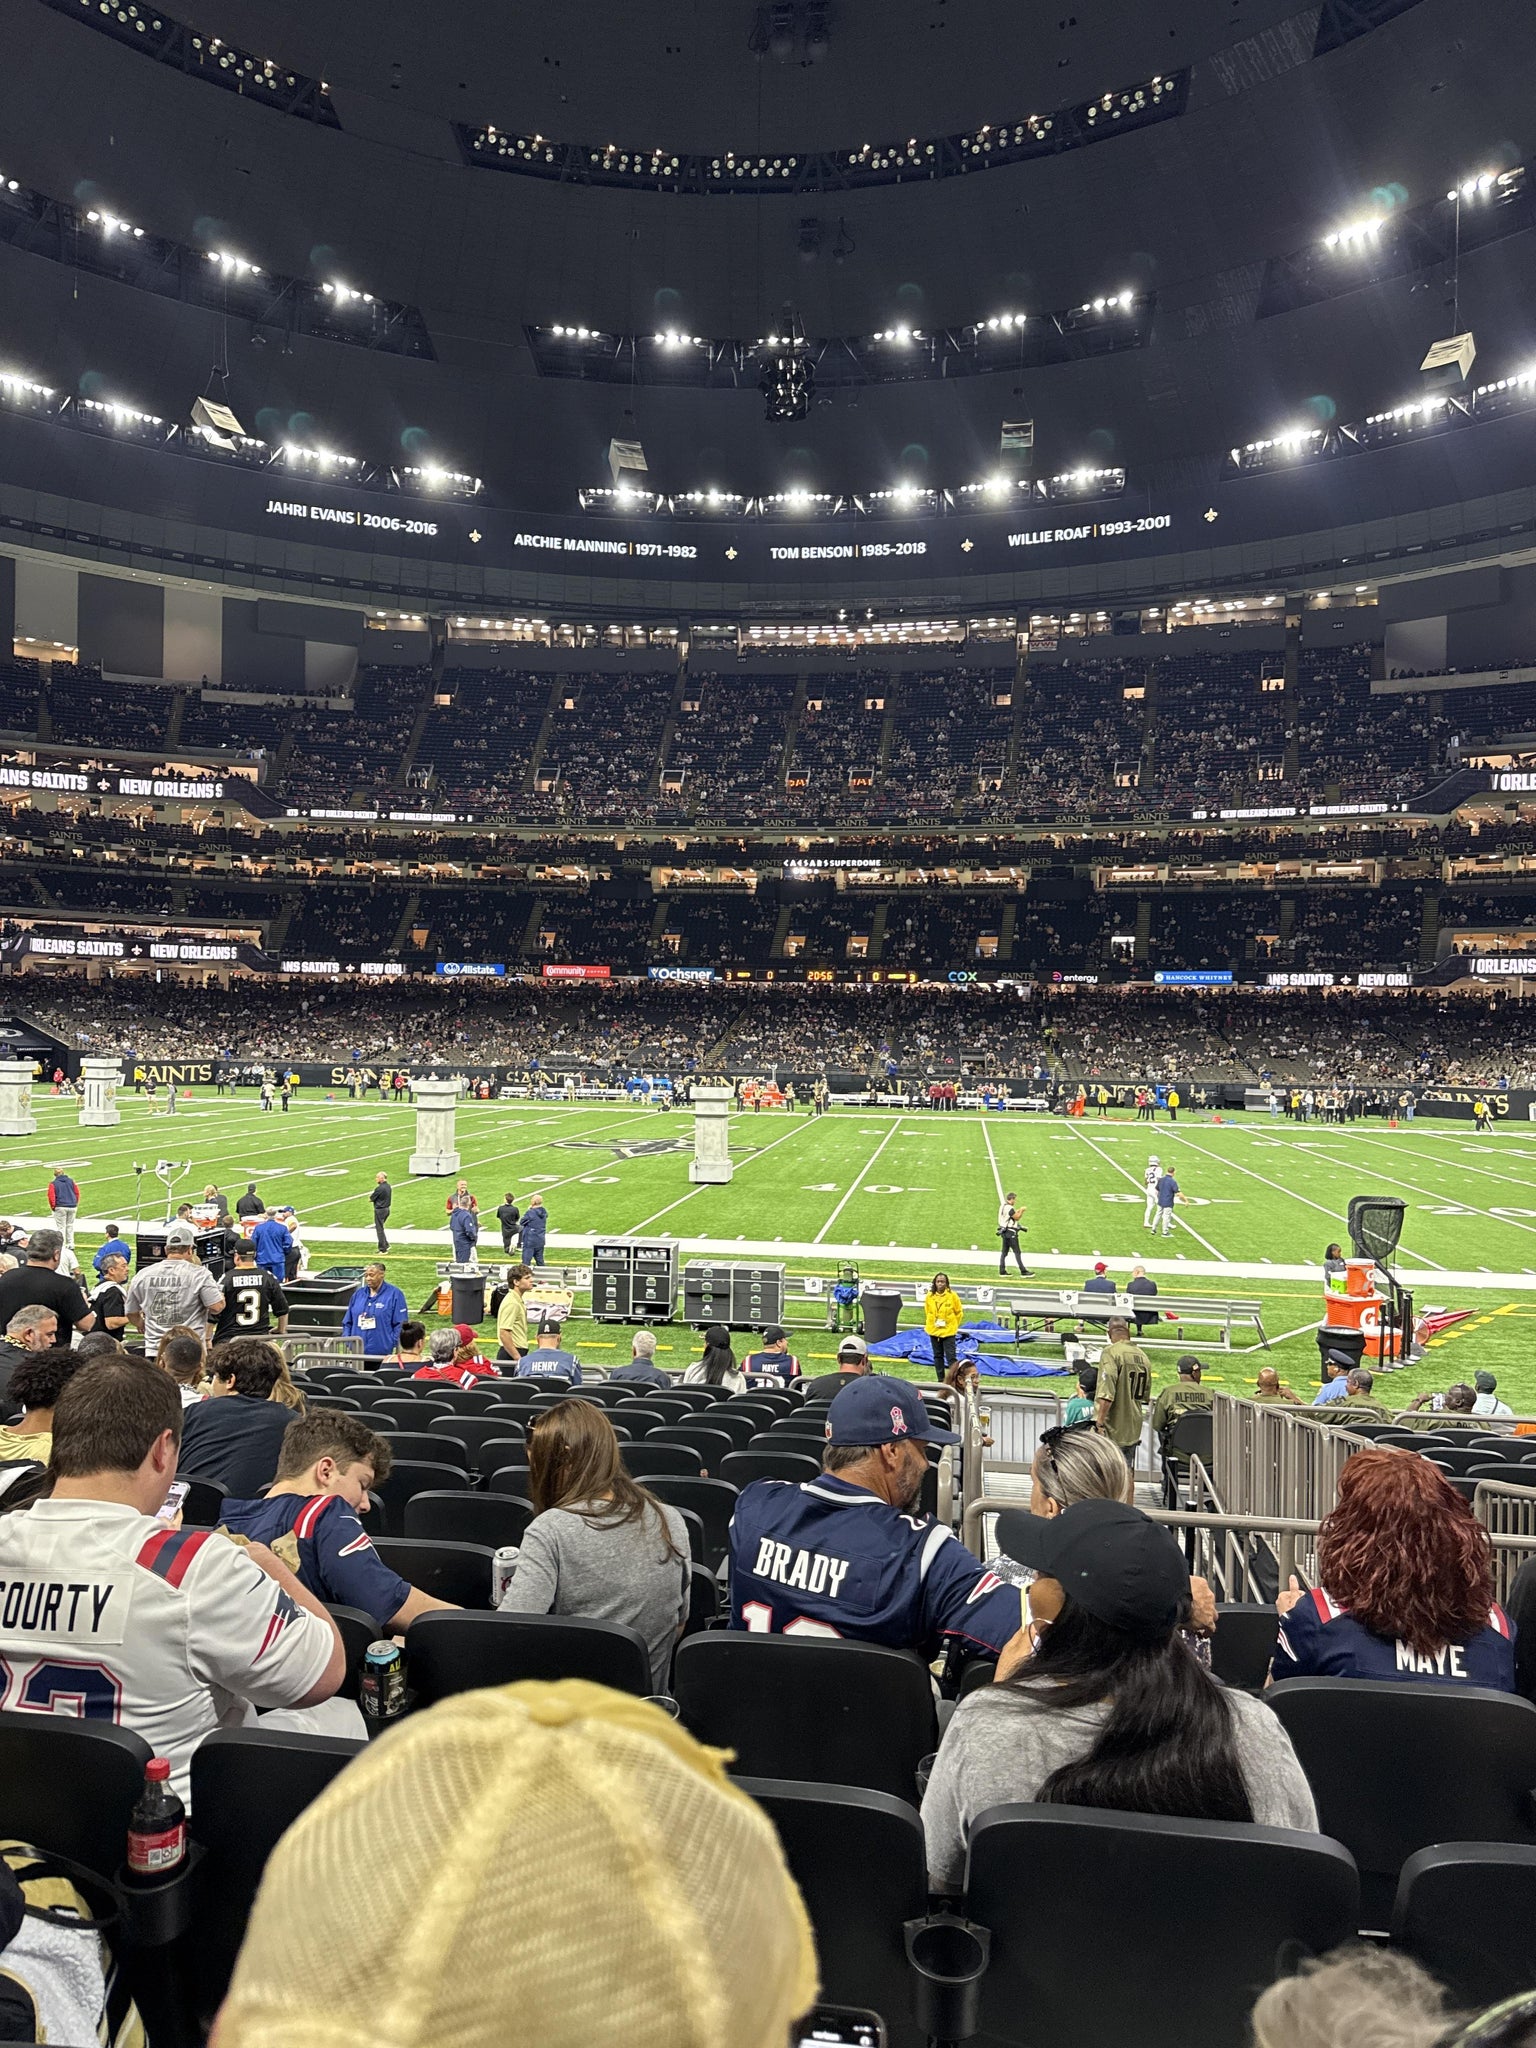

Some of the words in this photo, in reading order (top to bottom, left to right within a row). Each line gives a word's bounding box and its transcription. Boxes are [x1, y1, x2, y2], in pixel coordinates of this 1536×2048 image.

[265, 500, 307, 517] JAHRI
[310, 506, 355, 524] EVANS
[363, 513, 437, 536] 2006-2016
[1008, 530, 1053, 547] WILLIE
[1054, 524, 1091, 542] ROAF
[1099, 514, 1171, 537] 1993-2001
[514, 533, 562, 551] ARCHIE
[563, 538, 627, 555] MANNING
[635, 543, 697, 559] 1971-1982
[770, 546, 800, 560] TOM
[801, 544, 853, 559] BENSON
[861, 541, 927, 558] 1985-2018
[32, 772, 88, 791] SAINTS
[119, 778, 152, 795] NEW
[154, 780, 213, 798] ORLEANS
[555, 817, 587, 825] SAINTS
[907, 818, 941, 826] SAINTS
[980, 816, 1015, 825] SAINTS
[1055, 815, 1091, 823] SAINTS
[1133, 813, 1169, 821] SAINTS
[694, 819, 727, 827] SAINTS
[763, 819, 797, 827] SAINTS
[835, 819, 868, 827] SAINTS
[49, 830, 83, 840] SAINTS
[124, 838, 157, 847] SAINTS
[199, 843, 232, 852] SAINTS
[1496, 841, 1534, 853] SAINTS
[275, 847, 307, 855] SAINTS
[346, 851, 377, 859] SAINTS
[1244, 851, 1279, 861] SAINTS
[1327, 849, 1363, 859] SAINTS
[1408, 846, 1445, 856] SAINTS
[418, 853, 449, 861] SAINTS
[486, 855, 517, 863] SAINTS
[555, 857, 585, 865] SAINTS
[622, 858, 652, 866] SAINTS
[687, 858, 717, 866] SAINTS
[949, 858, 980, 866] SAINTS
[1020, 857, 1051, 865] SAINTS
[1091, 856, 1124, 864] SAINTS
[1168, 853, 1203, 863] SAINTS
[753, 859, 783, 867] SAINTS
[783, 859, 829, 867] CAESARS
[830, 859, 881, 867] SUPERDOME
[882, 859, 912, 867] SAINTS
[77, 941, 124, 957] SAINTS
[150, 944, 178, 959] NEW
[179, 945, 228, 960] ORLEANS
[301, 961, 340, 974] SAINTS
[360, 962, 384, 975] NEW
[460, 965, 496, 975] Allstate
[508, 966, 540, 974] SAINTS
[1476, 957, 1536, 974] ORLEANS
[546, 965, 586, 977] Community
[659, 968, 712, 980] Ochsner
[767, 971, 773, 980] 0
[1001, 972, 1034, 980] SAINTS
[726, 972, 732, 981] 3
[872, 972, 879, 981] 0
[909, 973, 916, 982] 3
[948, 971, 977, 982] COX
[1063, 973, 1098, 983] entergy
[1289, 974, 1334, 986] SAINTS
[1358, 974, 1384, 986] NEW
[1366, 1270, 1375, 1282] G
[149, 1276, 181, 1288] KAMARA
[232, 1275, 264, 1288] HEBERT
[151, 1290, 185, 1326] 41
[236, 1288, 261, 1327] 3
[1360, 1307, 1376, 1329] G
[532, 1361, 559, 1372] HENRY
[762, 1363, 779, 1373] MAYE
[1129, 1366, 1148, 1401] 10
[1175, 1392, 1206, 1403] ALFORD
[753, 1537, 850, 1599] BRADY
[0, 1581, 114, 1632] OURTY
[1395, 1638, 1468, 1678] MAYE
